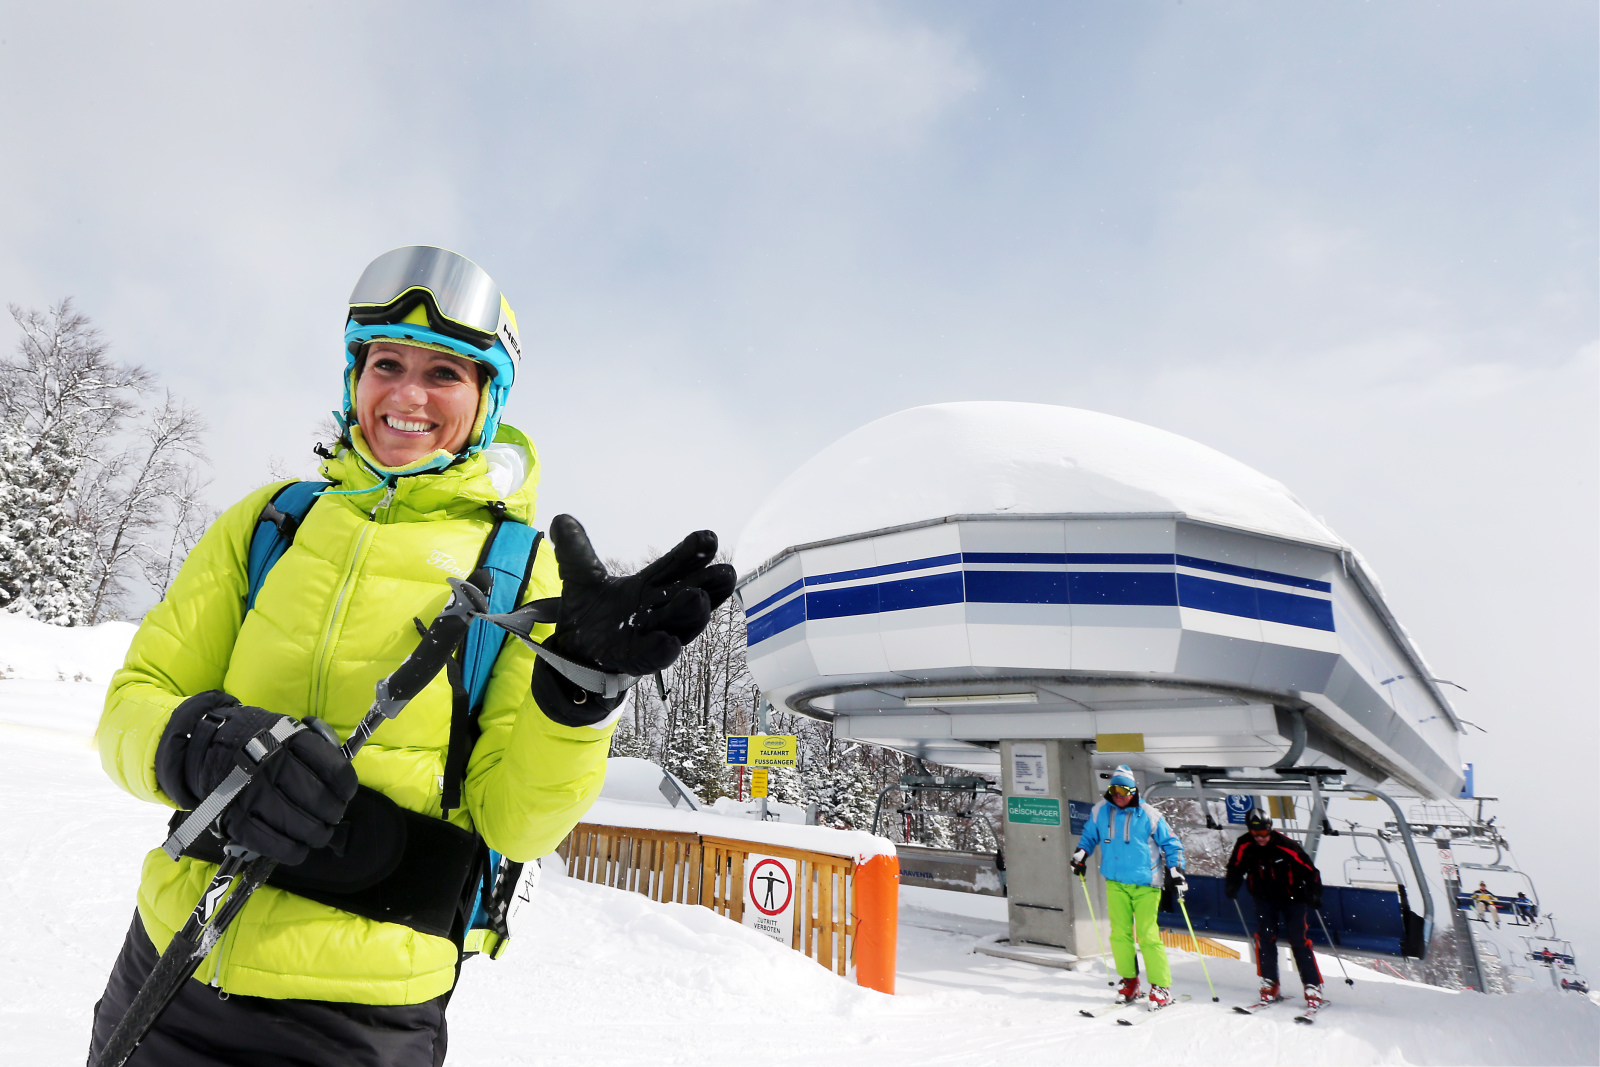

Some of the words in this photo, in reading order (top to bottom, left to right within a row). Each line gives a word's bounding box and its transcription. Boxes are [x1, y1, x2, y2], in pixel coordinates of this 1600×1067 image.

[503, 323, 522, 361] HEA
[426, 549, 473, 580] Head
[899, 869, 934, 879] ARAVENTA
[753, 922, 781, 934] VERBOTEN
